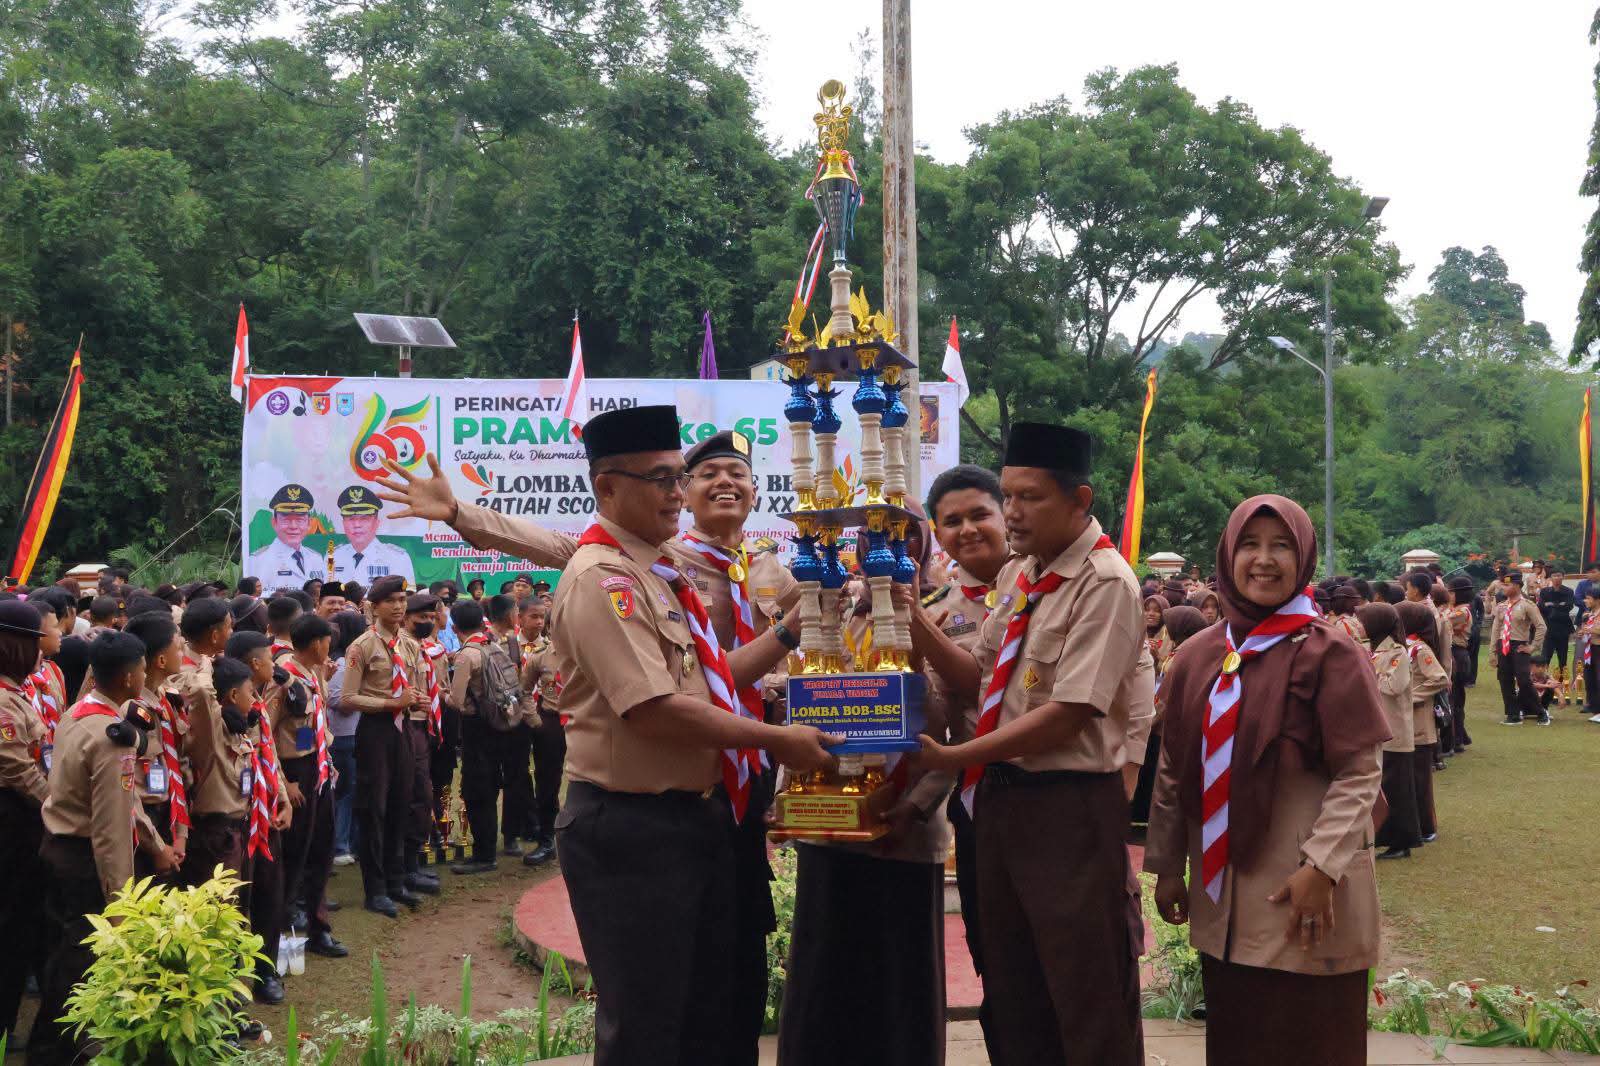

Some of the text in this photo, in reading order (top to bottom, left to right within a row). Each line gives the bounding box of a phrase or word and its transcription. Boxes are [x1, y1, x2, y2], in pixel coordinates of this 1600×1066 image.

[454, 397, 561, 412] PERINGAT
[453, 416, 584, 446] PRAM
[453, 449, 589, 464] Satyaku, Ku Dharmaka
[496, 475, 589, 494] LOMBA
[556, 496, 597, 515] SCO
[461, 561, 504, 574] Menuju
[791, 704, 901, 717] LOMBA BOB-BSC
[848, 729, 901, 737] PAYAKUMBUH
